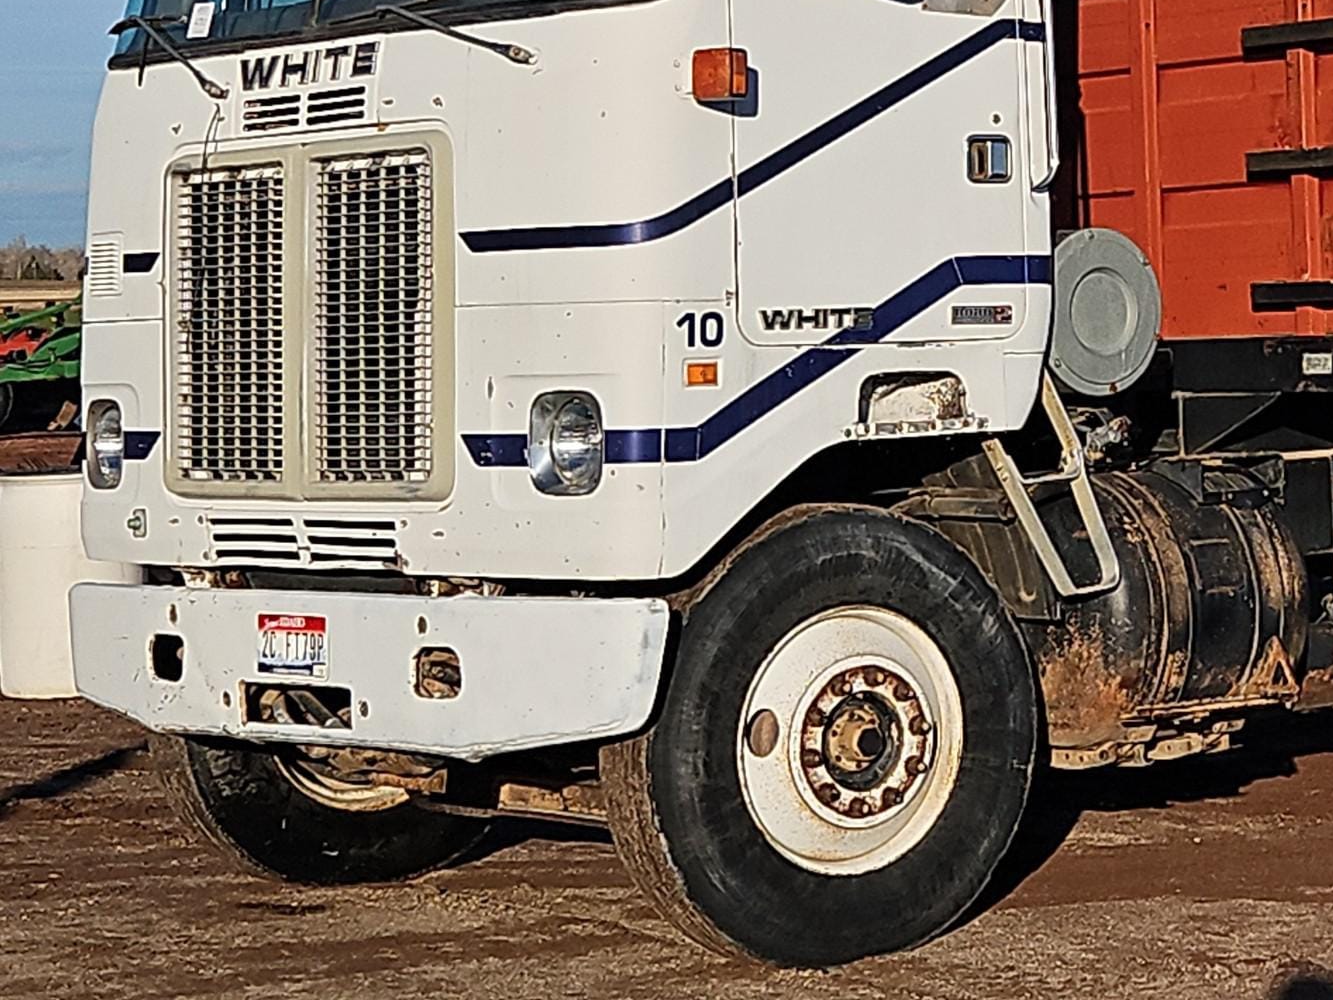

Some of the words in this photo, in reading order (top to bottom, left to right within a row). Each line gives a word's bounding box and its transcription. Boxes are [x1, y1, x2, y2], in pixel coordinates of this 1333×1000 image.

[240, 41, 380, 91] WHITE
[676, 311, 724, 348] 10
[759, 307, 873, 330] WHITE
